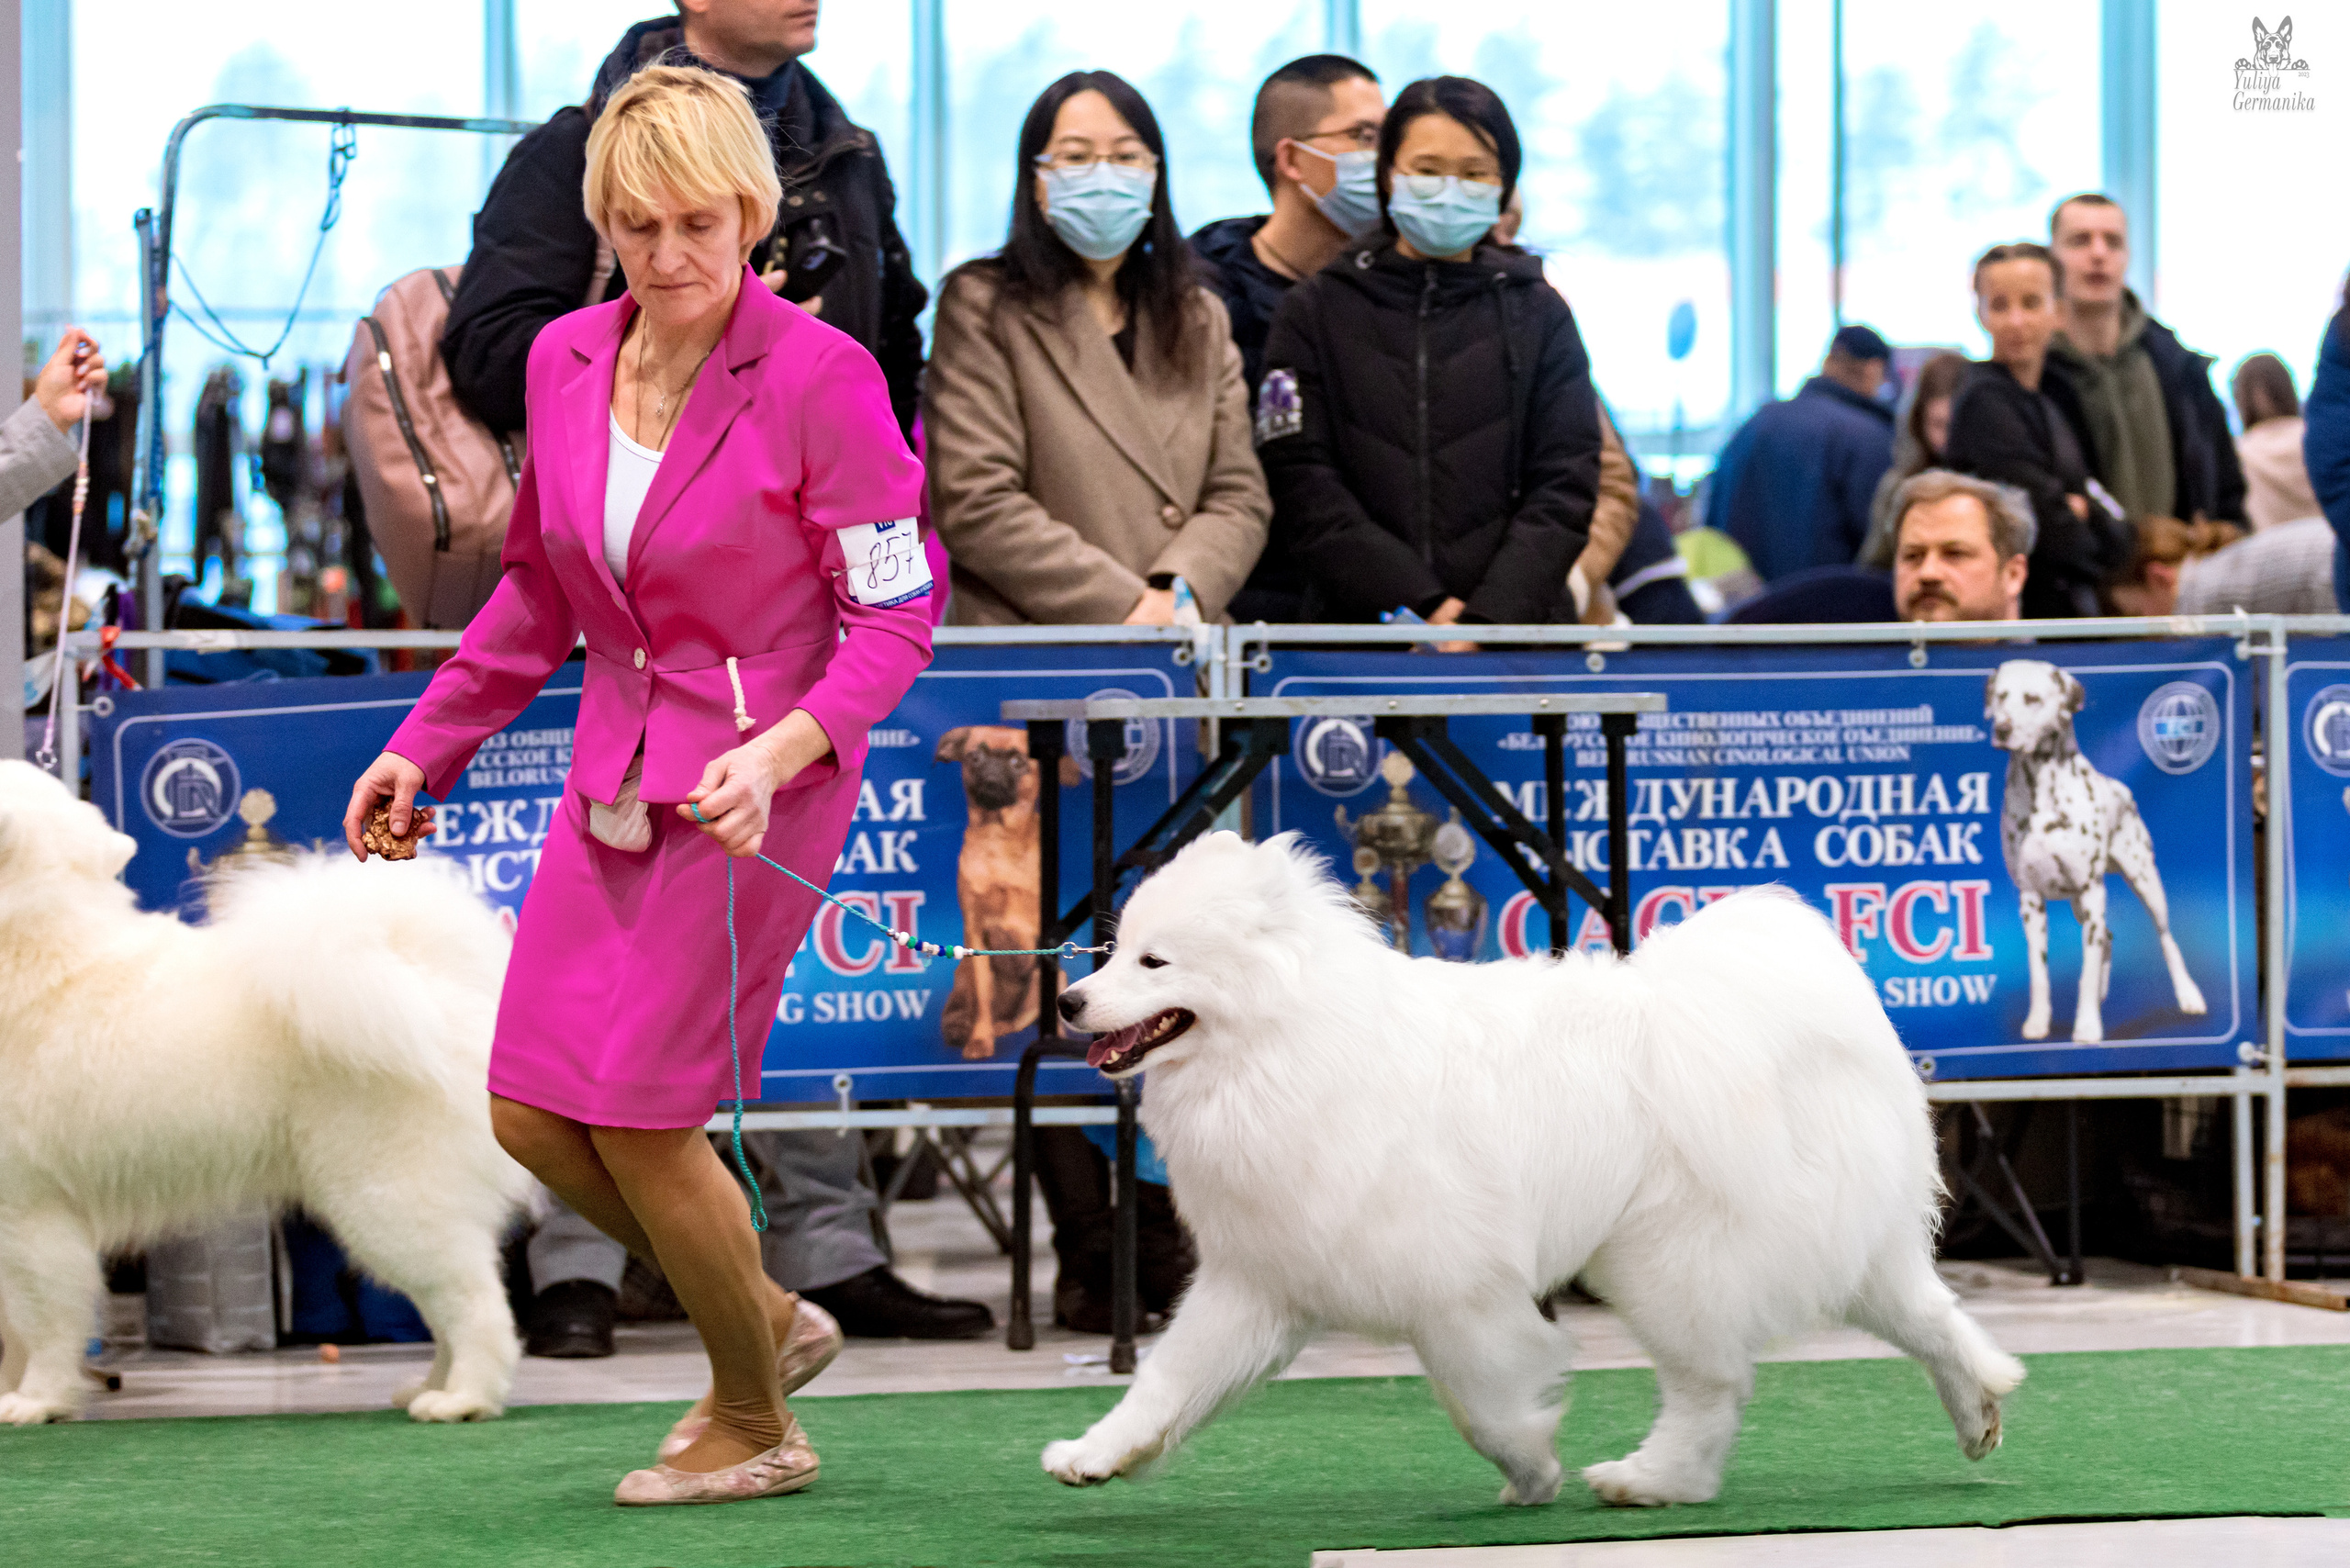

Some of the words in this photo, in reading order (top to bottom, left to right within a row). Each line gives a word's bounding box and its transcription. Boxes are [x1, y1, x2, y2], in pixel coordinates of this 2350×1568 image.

[867, 531, 914, 588] 857
[1813, 821, 1984, 868] СОБАК
[785, 890, 926, 978] CI
[812, 989, 932, 1025] SHOW
[1884, 973, 1998, 1008] SHOW
